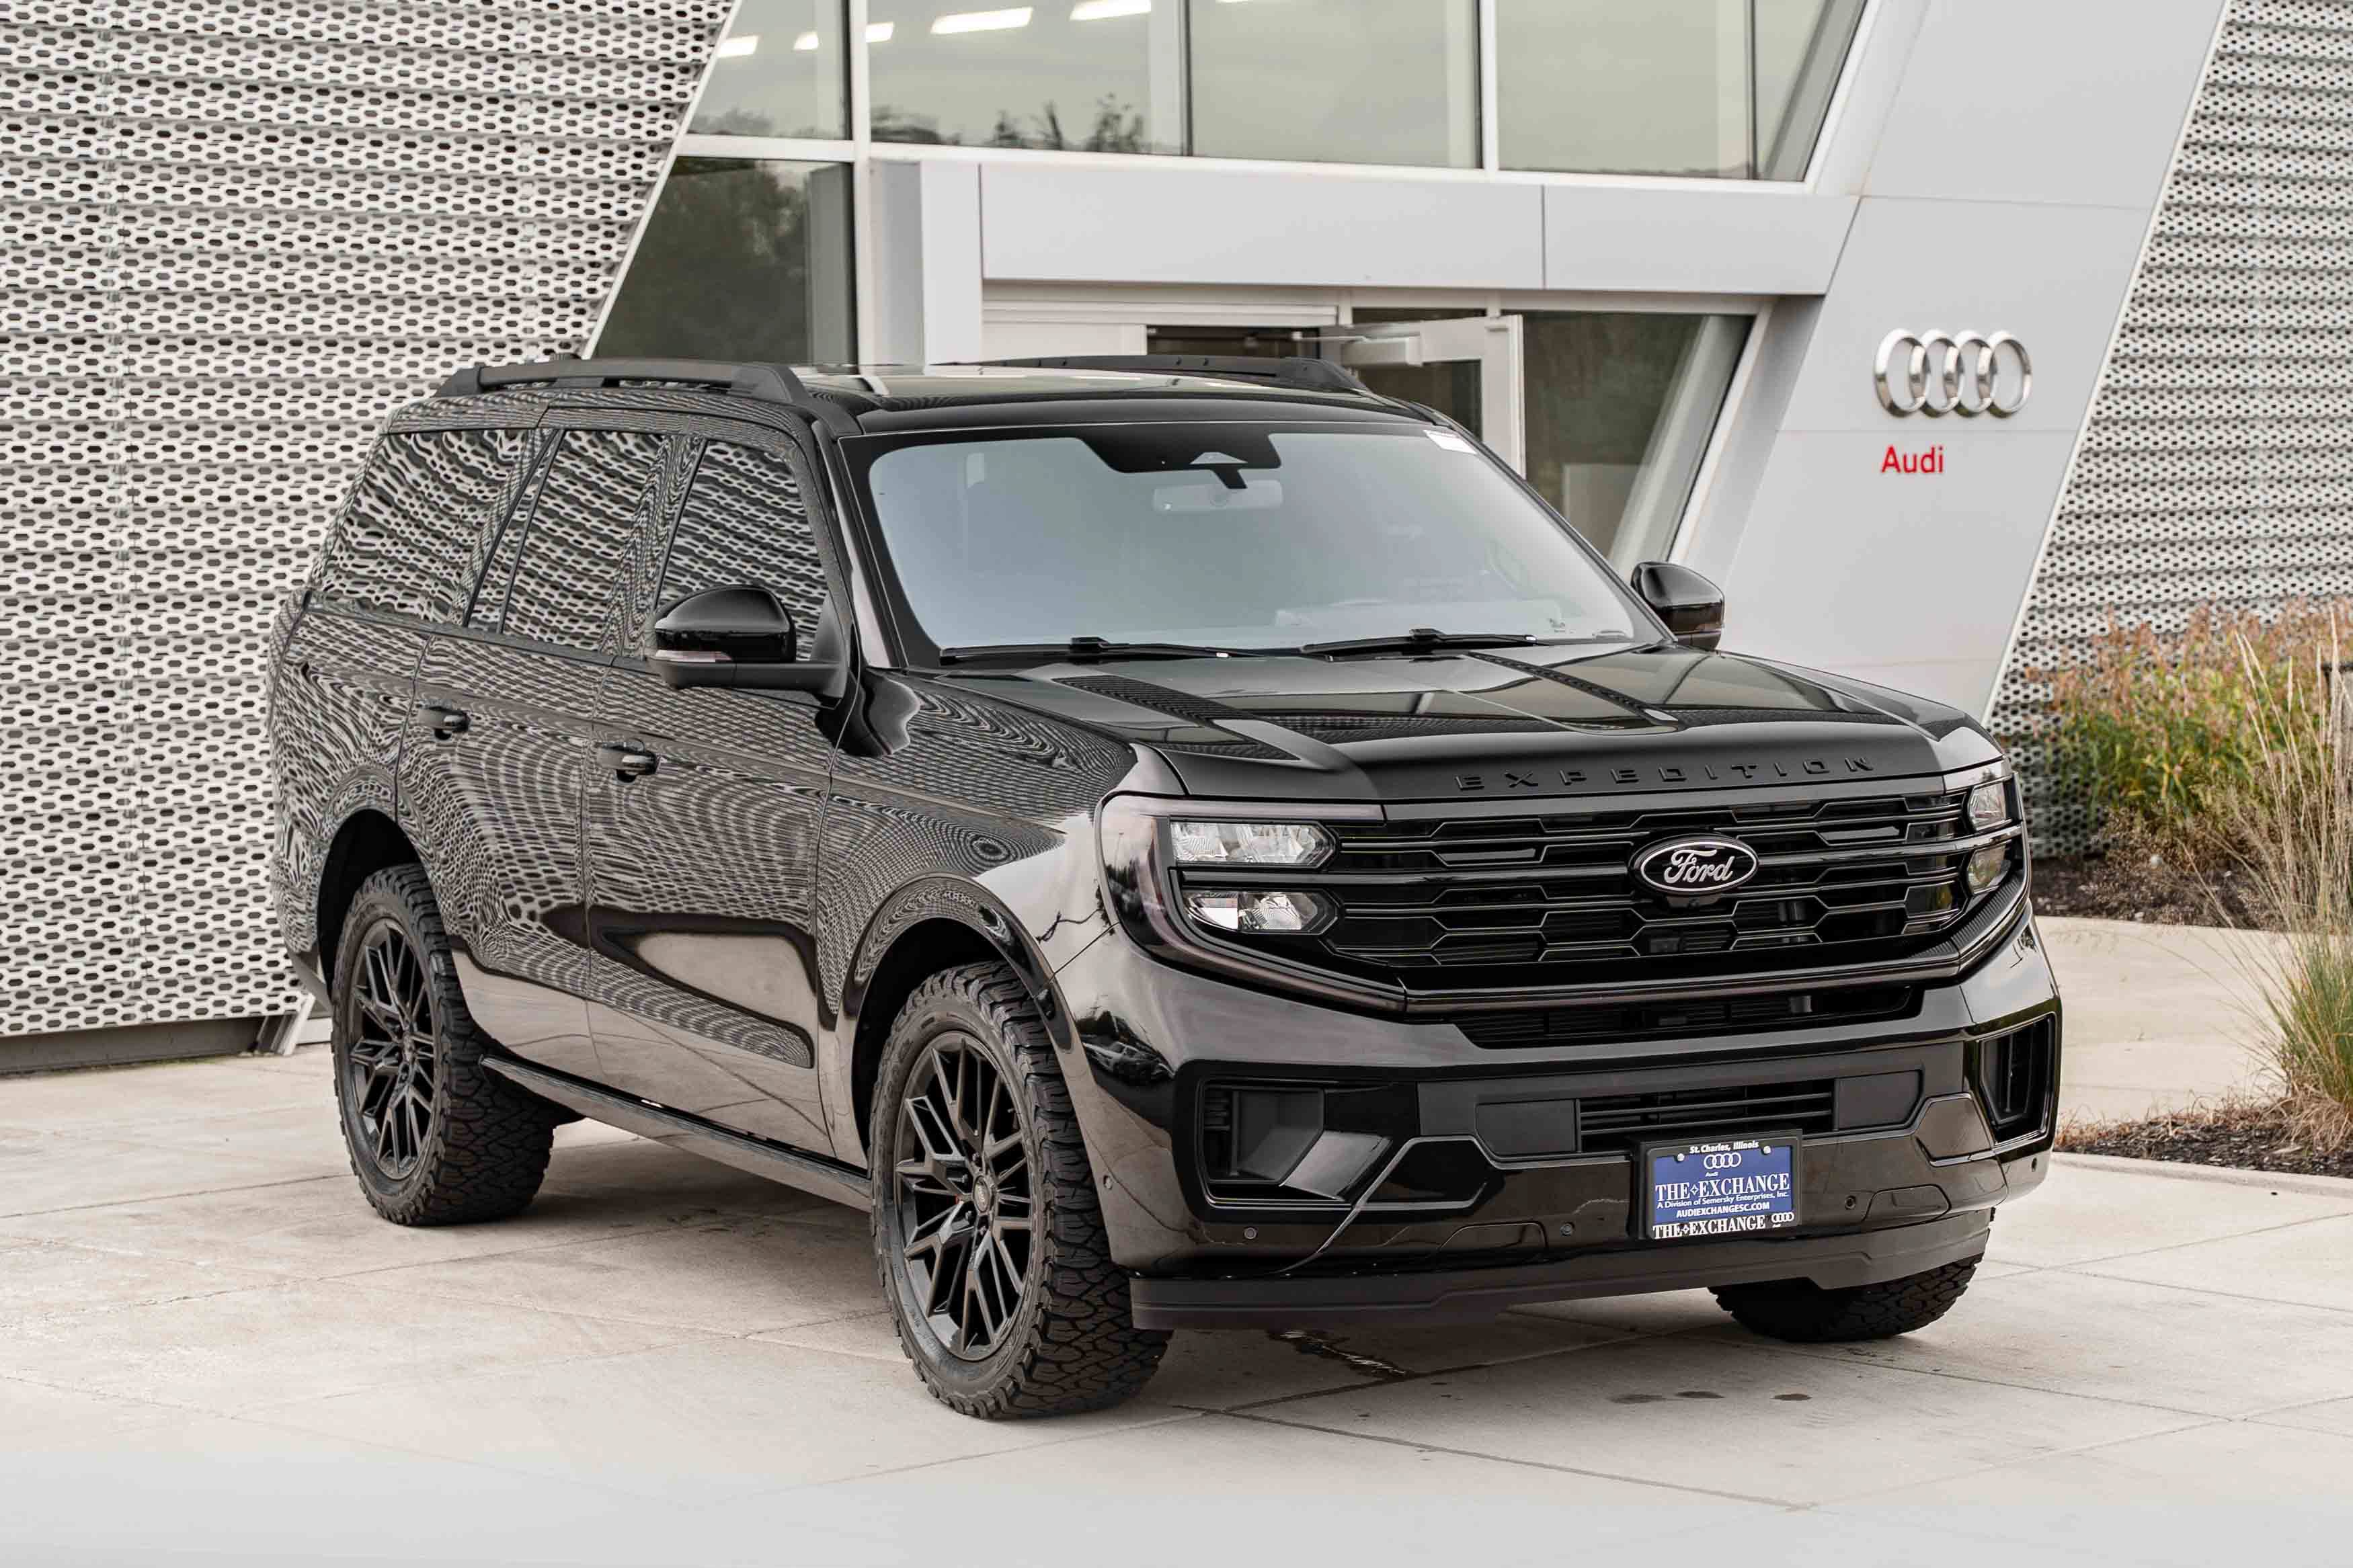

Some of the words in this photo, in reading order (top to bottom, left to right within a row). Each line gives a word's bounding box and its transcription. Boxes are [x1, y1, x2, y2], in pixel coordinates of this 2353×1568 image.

[1880, 444, 1944, 474] Audi
[1455, 757, 1876, 792] EXPEDITION
[1663, 848, 1737, 884] Ford
[1689, 1145, 1700, 1154] St.
[1700, 1143, 1731, 1153] Charles,
[1732, 1140, 1759, 1150] Illinois
[1655, 1182, 1690, 1202] THE
[1698, 1173, 1790, 1198] EXCHANGE
[1665, 1200, 1692, 1208] Division
[1736, 1192, 1776, 1202] Enterprises,
[1676, 1202, 1770, 1219] AUDIEXCHANGESC.COM
[1652, 1223, 1683, 1240] THE
[1689, 1214, 1766, 1235] EXCHANGE
